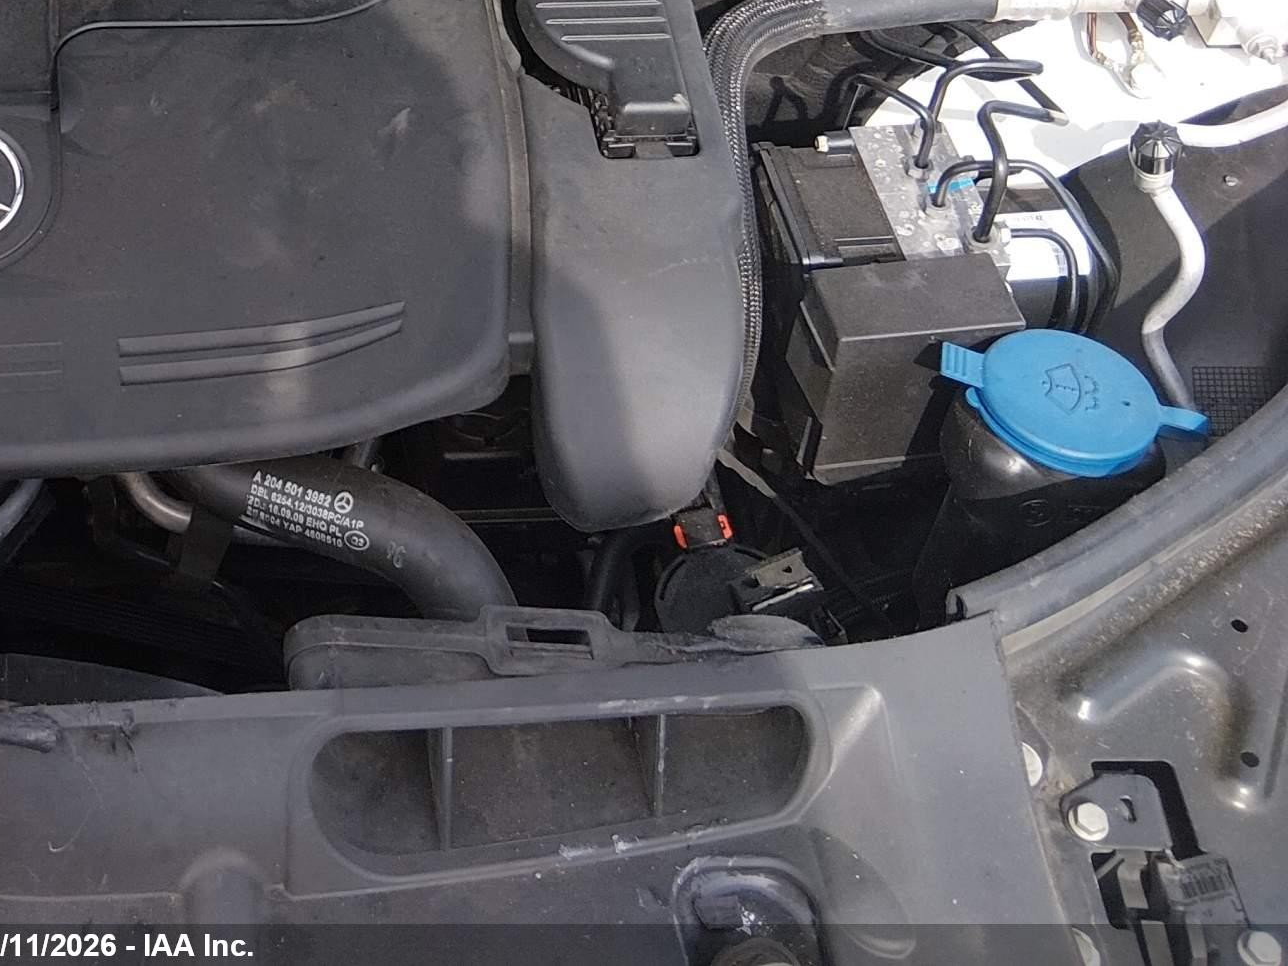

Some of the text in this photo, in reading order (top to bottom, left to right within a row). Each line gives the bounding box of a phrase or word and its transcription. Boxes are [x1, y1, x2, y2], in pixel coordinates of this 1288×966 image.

[252, 470, 262, 484] A
[263, 474, 283, 491] 204
[304, 489, 332, 508] 3982
[329, 524, 343, 538] PL
